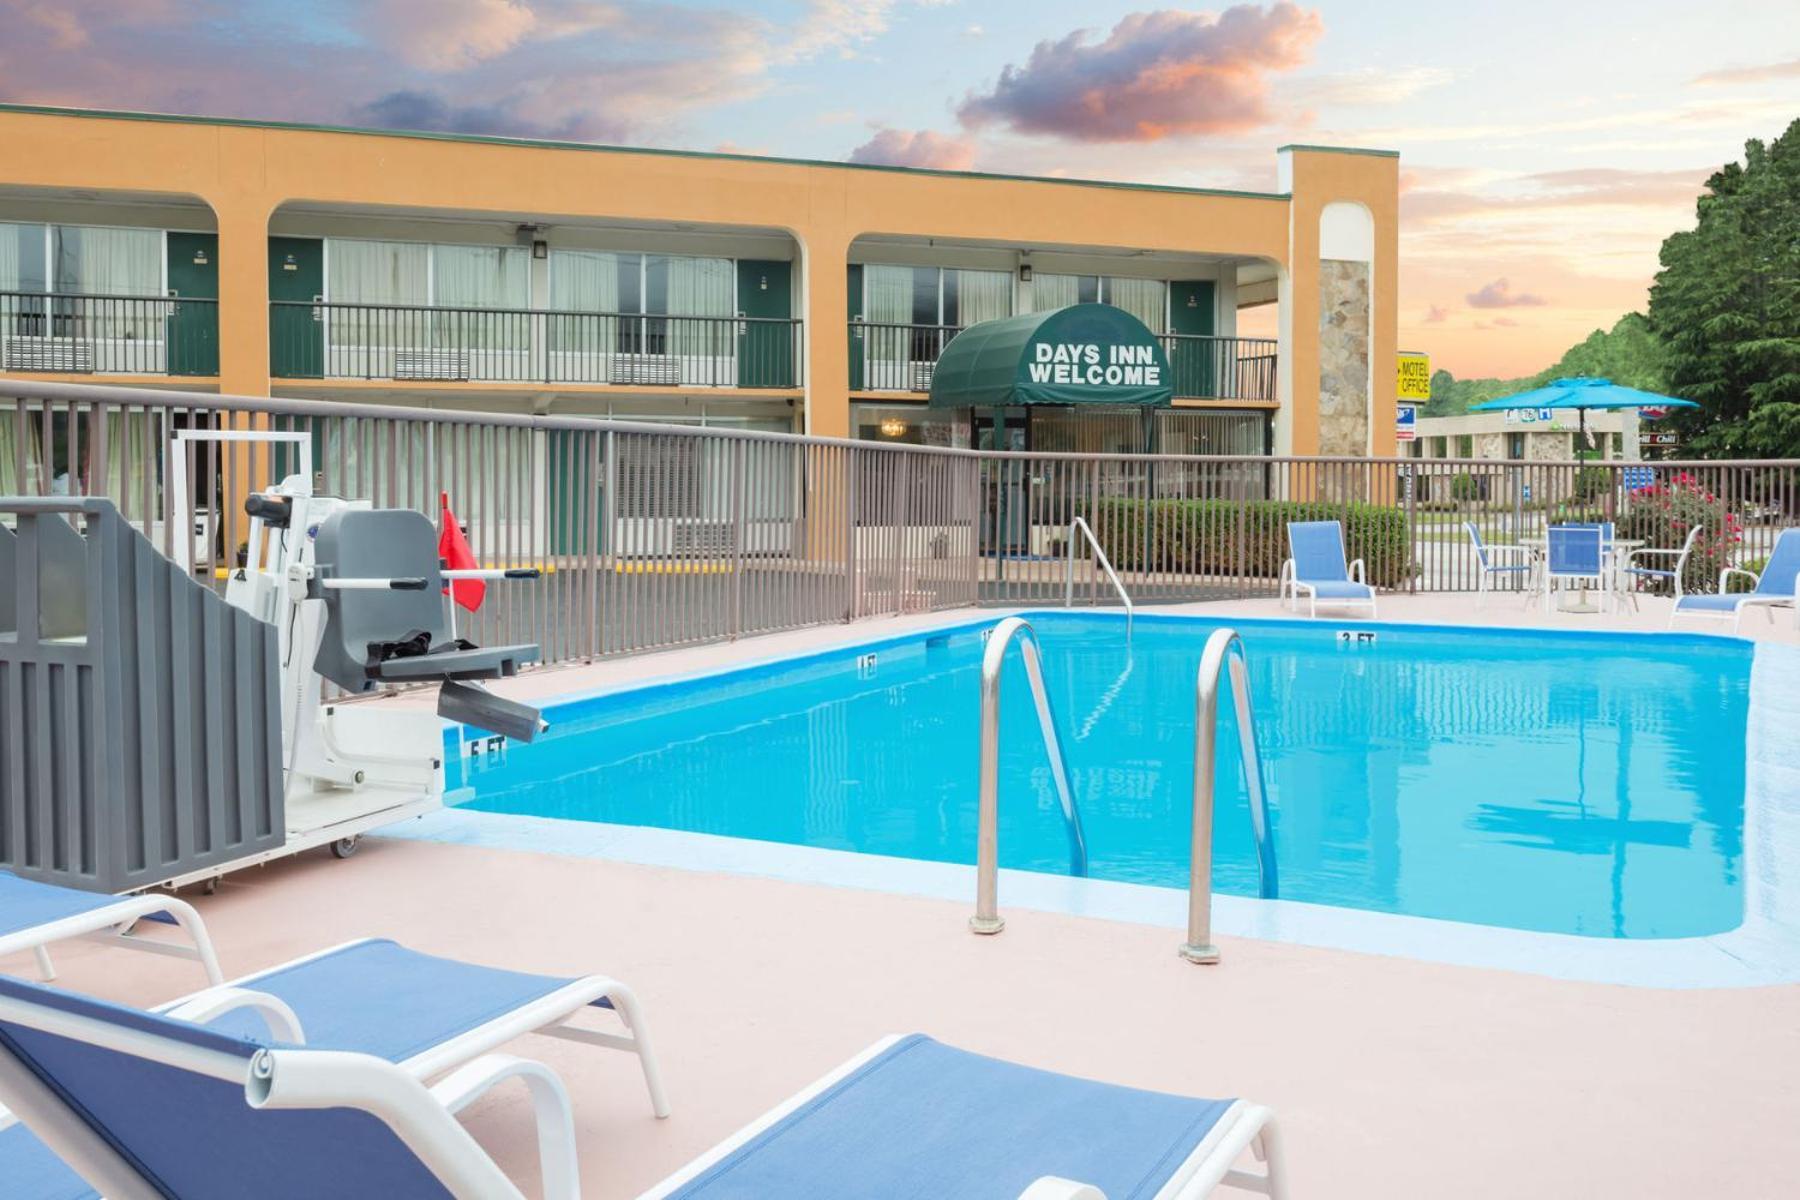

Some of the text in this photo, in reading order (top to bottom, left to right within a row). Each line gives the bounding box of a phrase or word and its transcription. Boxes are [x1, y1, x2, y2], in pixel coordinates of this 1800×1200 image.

[1036, 343, 1100, 365] DAYS
[1029, 364, 1160, 385] WELCOME
[1403, 362, 1428, 376] MOTEL
[1403, 378, 1428, 393] OFFICE
